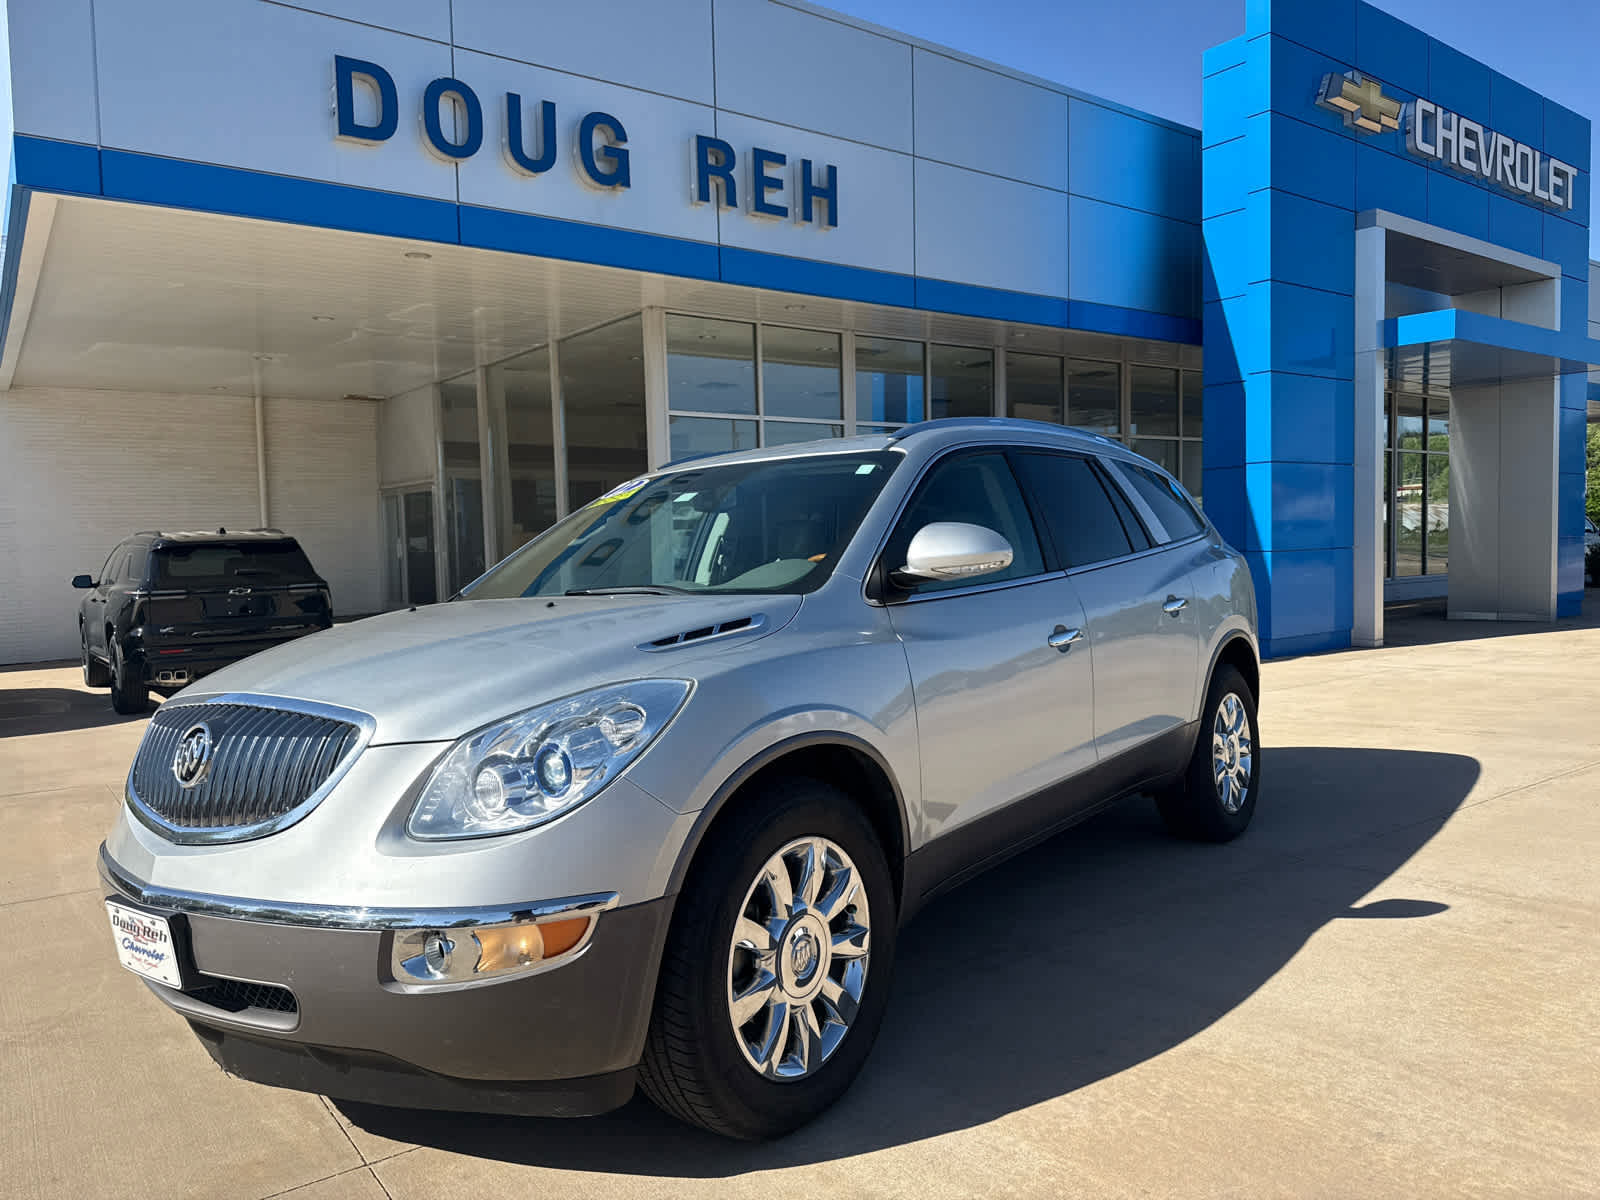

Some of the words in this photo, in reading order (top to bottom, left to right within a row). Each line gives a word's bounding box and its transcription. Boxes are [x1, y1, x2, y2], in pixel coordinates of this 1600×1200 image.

[335, 54, 631, 189] DOUG
[694, 133, 838, 228] REH
[1415, 98, 1578, 210] CHEVROLET
[112, 914, 141, 937] Doug
[142, 926, 168, 943] Reh
[121, 937, 166, 961] Chevrolet
